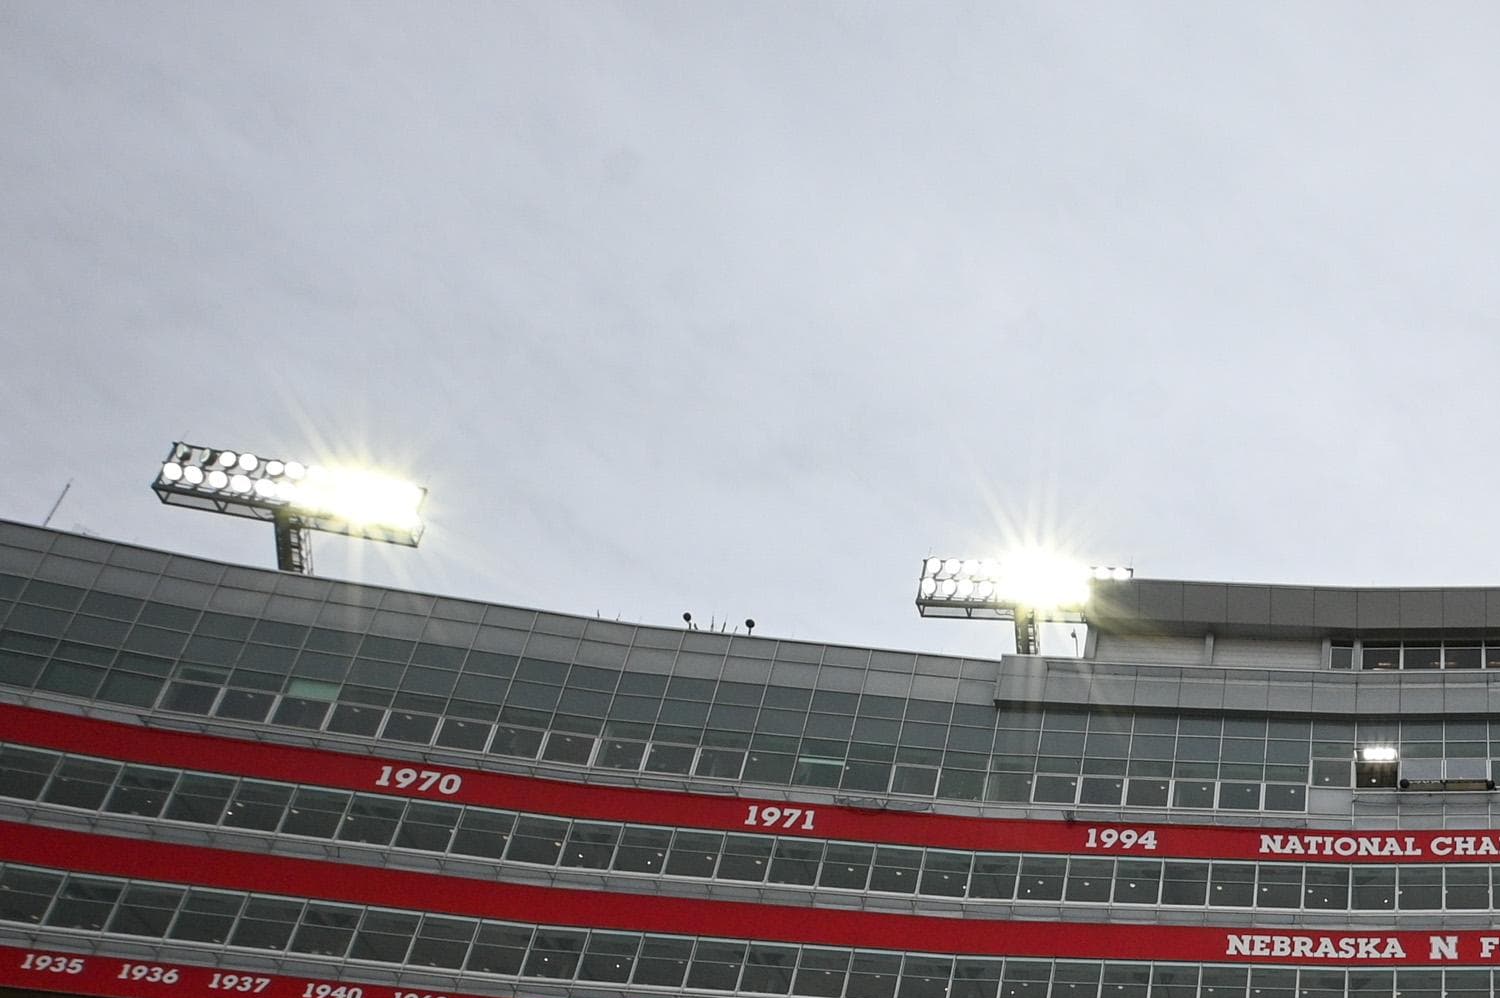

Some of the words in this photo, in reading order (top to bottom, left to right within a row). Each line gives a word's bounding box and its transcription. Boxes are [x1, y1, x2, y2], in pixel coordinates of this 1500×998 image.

[375, 765, 462, 795] 1970
[744, 805, 815, 830] 1971
[1085, 828, 1158, 850] 1994
[1259, 834, 1422, 856] NATIONAL
[1225, 934, 1407, 959] NEBRASKA
[1429, 935, 1458, 960] N
[20, 953, 84, 974] 1935
[117, 963, 179, 984] 1936
[208, 972, 270, 993] 1937
